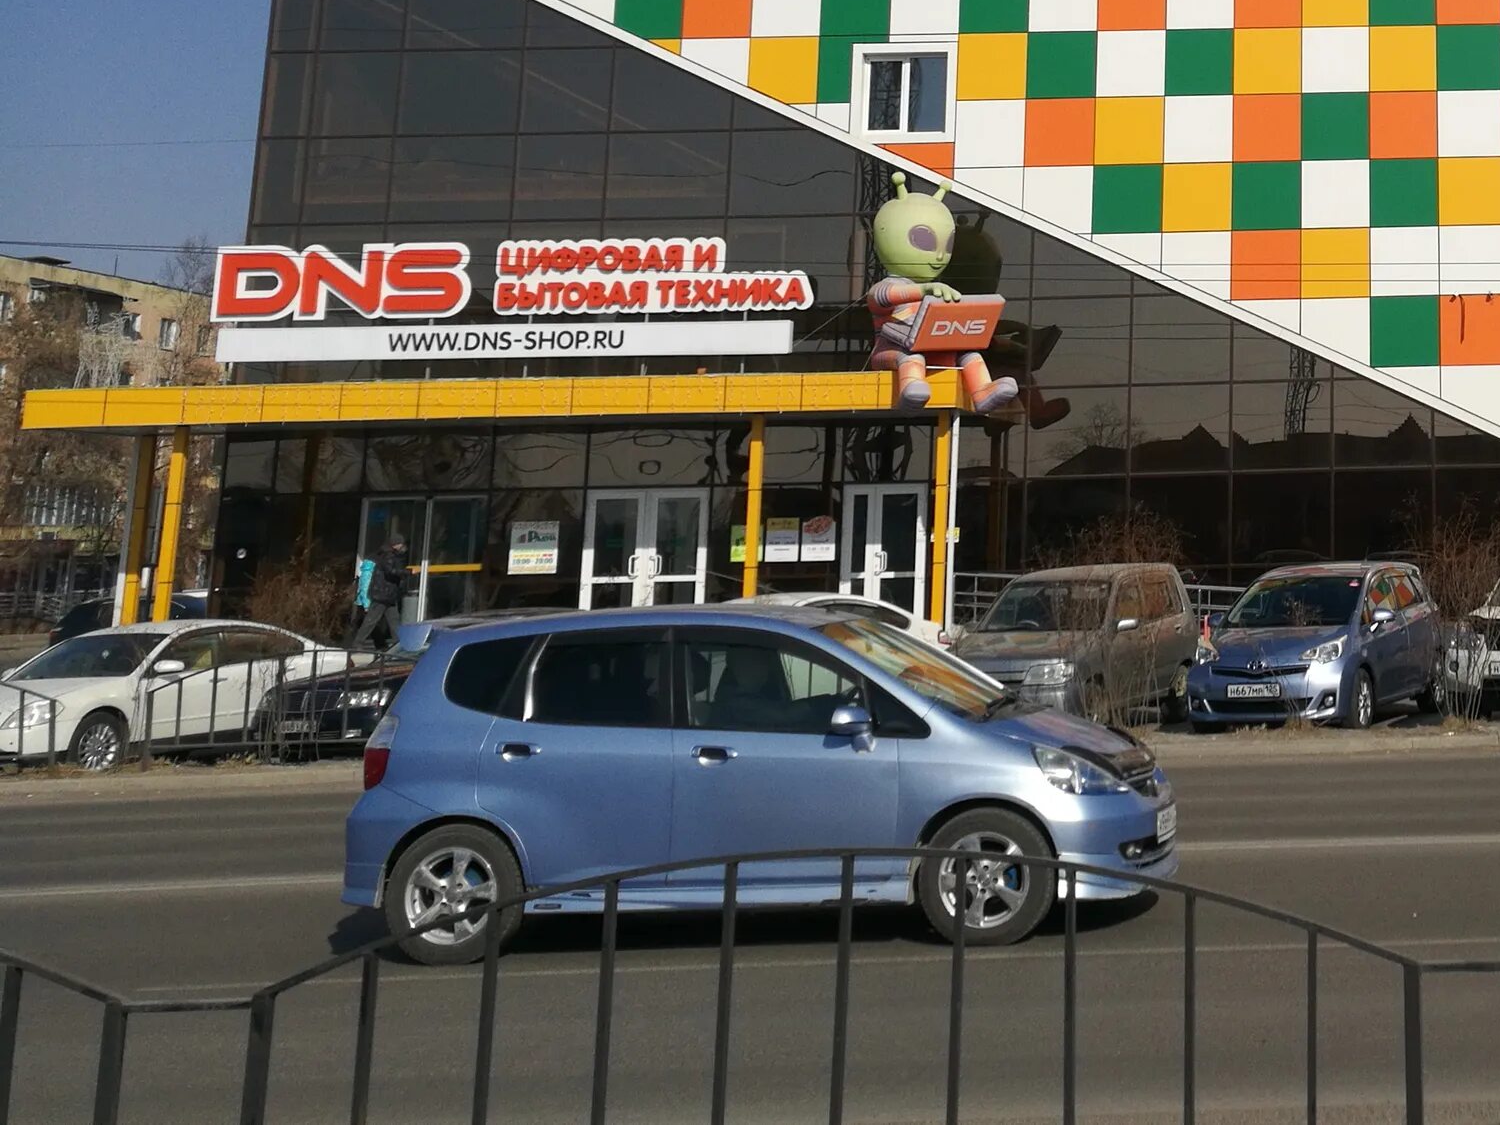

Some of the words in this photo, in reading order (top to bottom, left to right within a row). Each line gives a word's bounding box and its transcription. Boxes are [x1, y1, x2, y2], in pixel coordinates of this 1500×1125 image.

[499, 244, 686, 279] ЦИФРОВАЯ
[693, 243, 718, 272] И
[212, 245, 467, 320] DNS
[496, 280, 649, 310] БЫТОВАЯ
[656, 277, 807, 308] ТЕХНИКА
[388, 330, 624, 353] WWW.DNS-SHOP.RU
[930, 319, 988, 336] DNS
